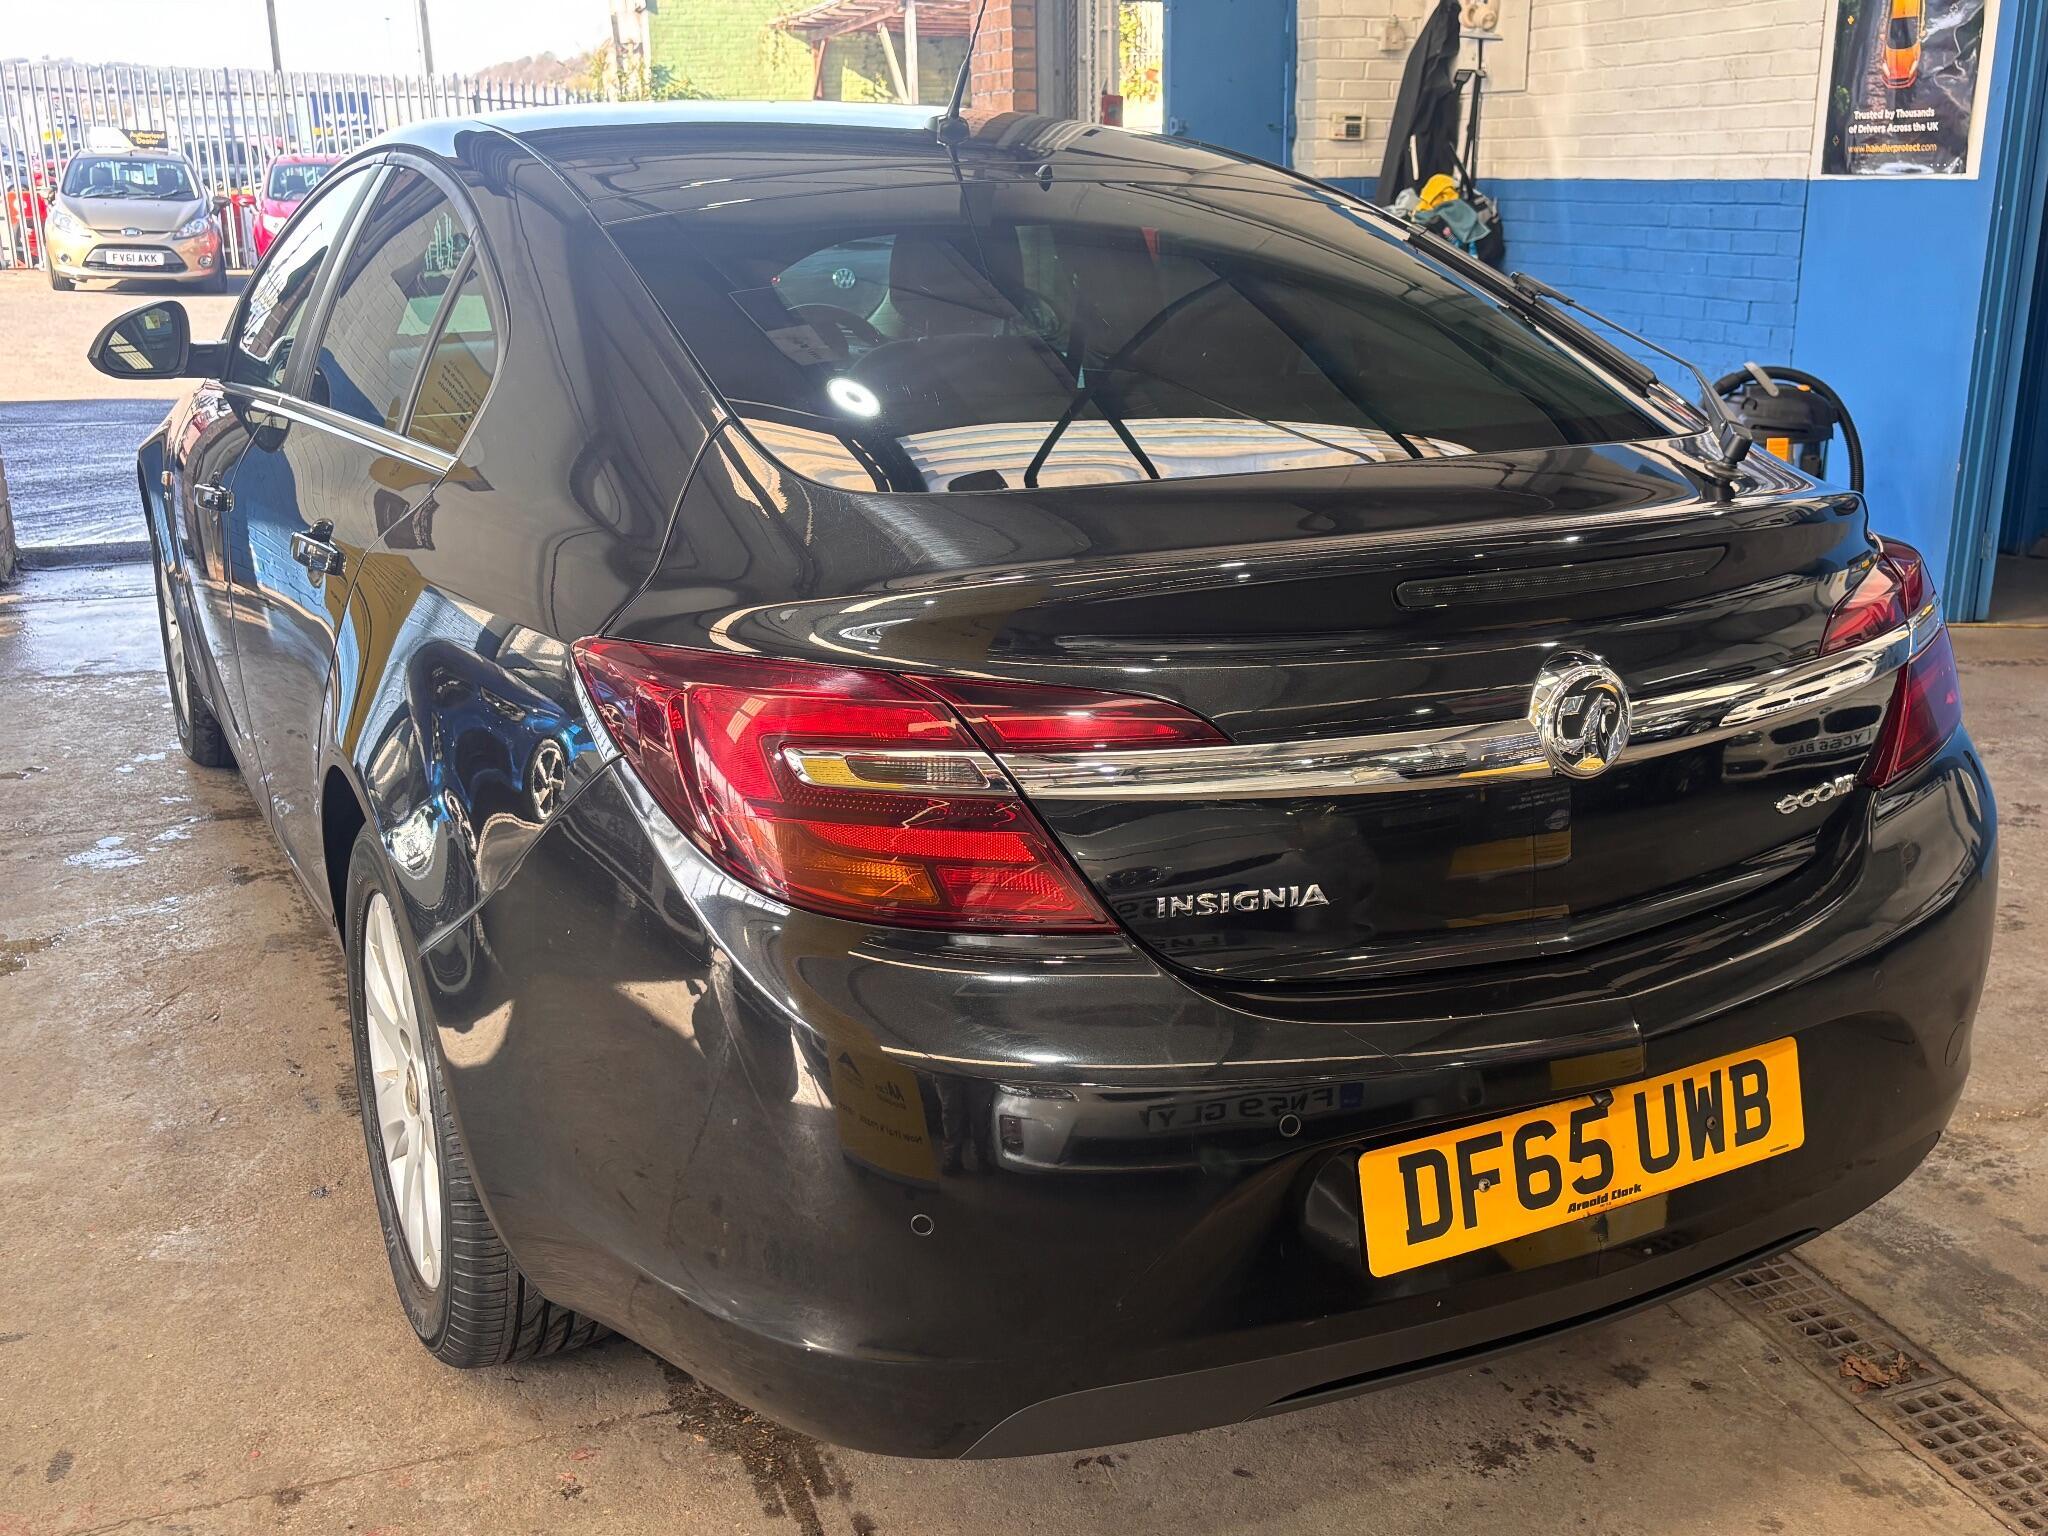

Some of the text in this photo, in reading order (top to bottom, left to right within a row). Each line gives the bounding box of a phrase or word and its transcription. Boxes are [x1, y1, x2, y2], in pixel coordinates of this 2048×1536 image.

[1853, 107, 1935, 120] Trusted by Thousands
[1848, 121, 1939, 134] of Drivers Across the UK
[113, 253, 158, 263] FV61 AKK
[1156, 883, 1330, 919] INSIGNIA
[1398, 1058, 1772, 1246] DF65 UWB
[1567, 1183, 1642, 1214] Arnold Clark
